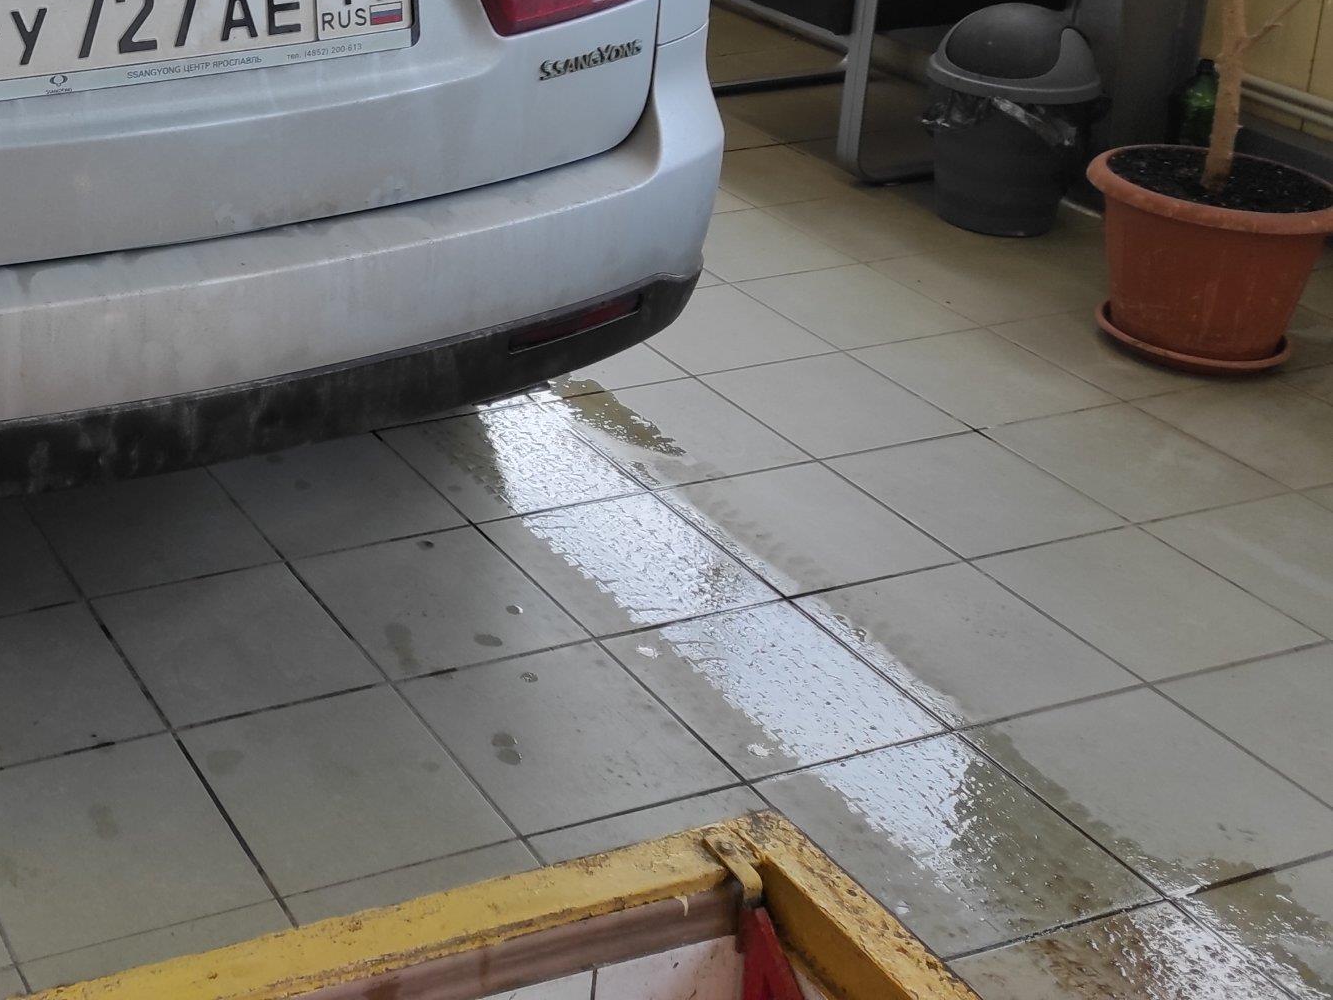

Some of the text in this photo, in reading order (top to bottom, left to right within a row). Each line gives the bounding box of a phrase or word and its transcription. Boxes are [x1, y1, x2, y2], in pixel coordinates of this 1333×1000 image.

[321, 7, 368, 32] RUS
[126, 65, 181, 80] SSANGYONG
[183, 61, 211, 73] ЦЕНТР
[212, 55, 263, 69] ЯРОСЛАВЛЬ
